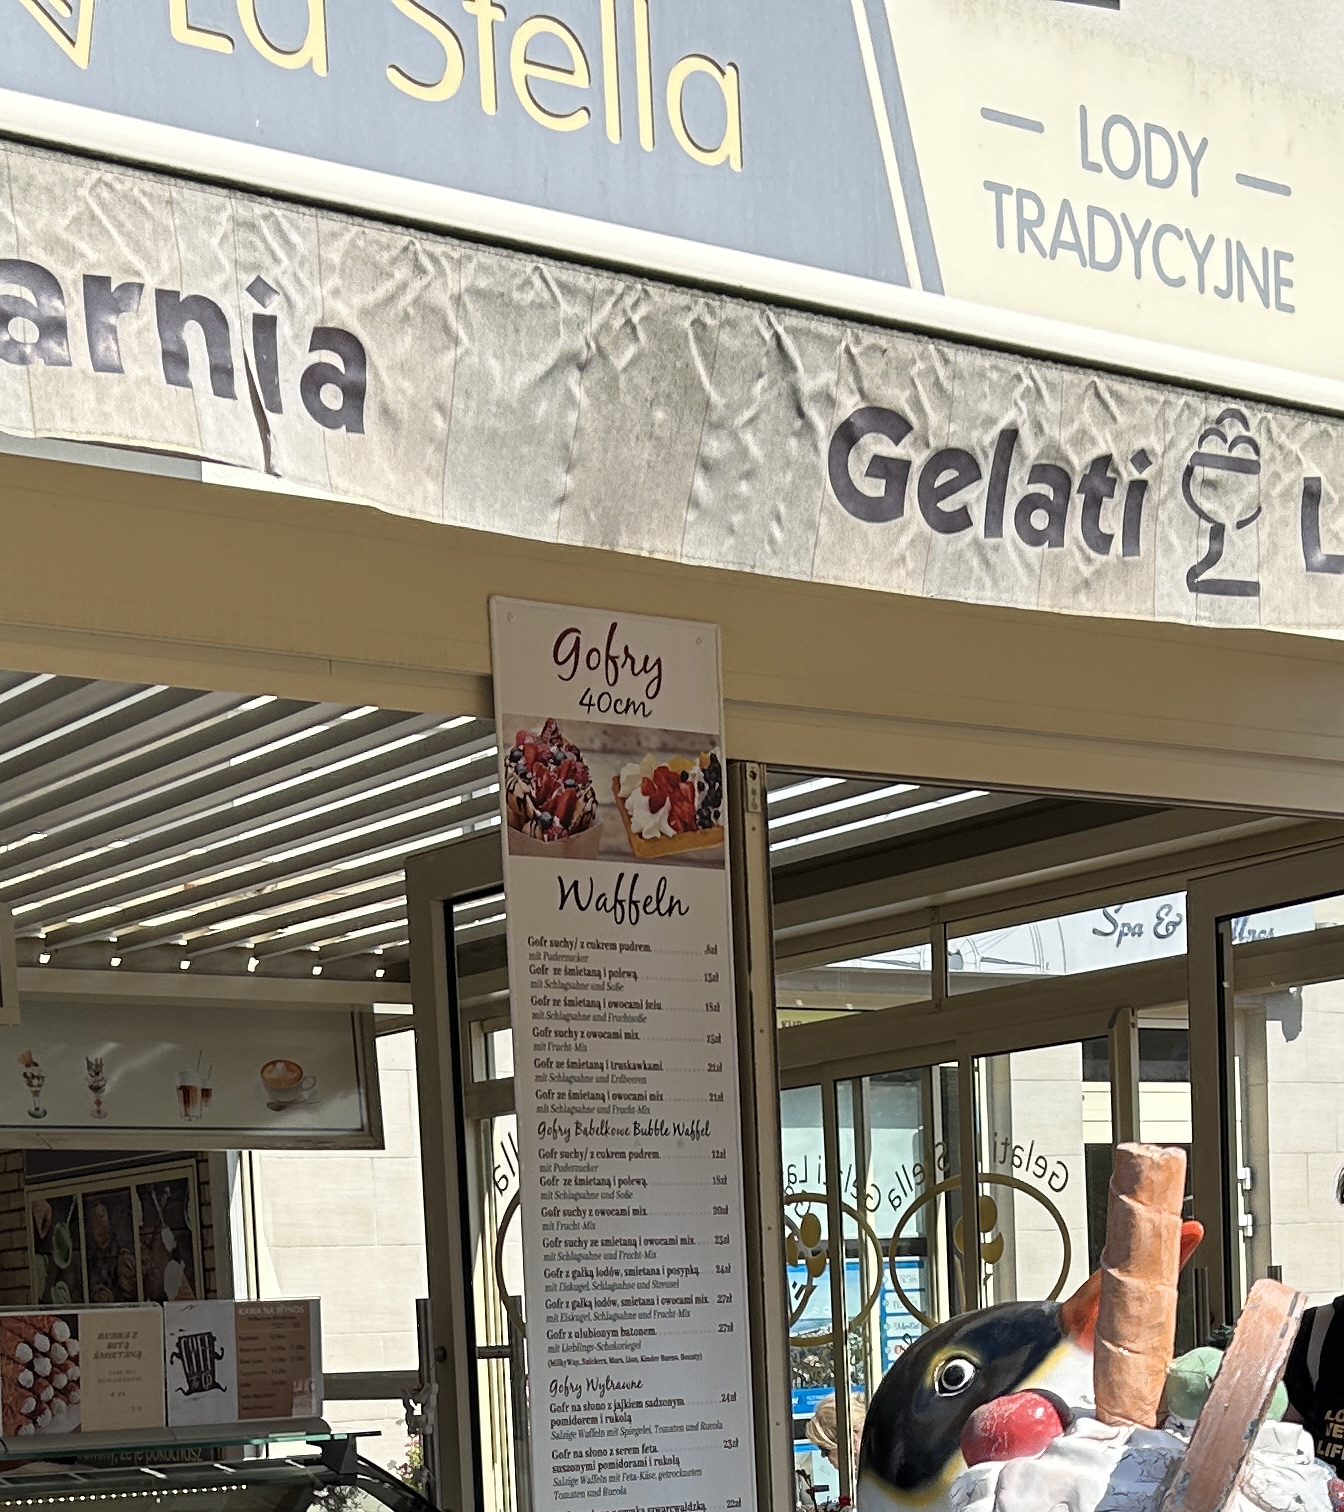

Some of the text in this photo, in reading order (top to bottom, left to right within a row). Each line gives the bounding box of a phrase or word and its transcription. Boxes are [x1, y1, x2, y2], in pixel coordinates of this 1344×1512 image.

[386, 0, 744, 173] Stella
[1077, 105, 1209, 200] LODY
[982, 180, 1296, 315] TRADYCYJNE
[827, 406, 1153, 560] Gelati
[553, 622, 662, 699] Gofry
[578, 688, 653, 718] 40cm
[558, 873, 689, 925] Waffeln
[528, 936, 547, 947] Gofr
[586, 938, 617, 951] cukrem
[1092, 905, 1144, 948] Spa
[1153, 904, 1183, 939] &
[534, 1058, 553, 1069] Gofr
[538, 1118, 571, 1143] Gofry
[633, 1119, 671, 1137] Bubble
[672, 1120, 711, 1142] Waffel
[549, 1375, 582, 1399] Gofry
[551, 1415, 598, 1429] pomidorem
[552, 1449, 571, 1460] Gofr
